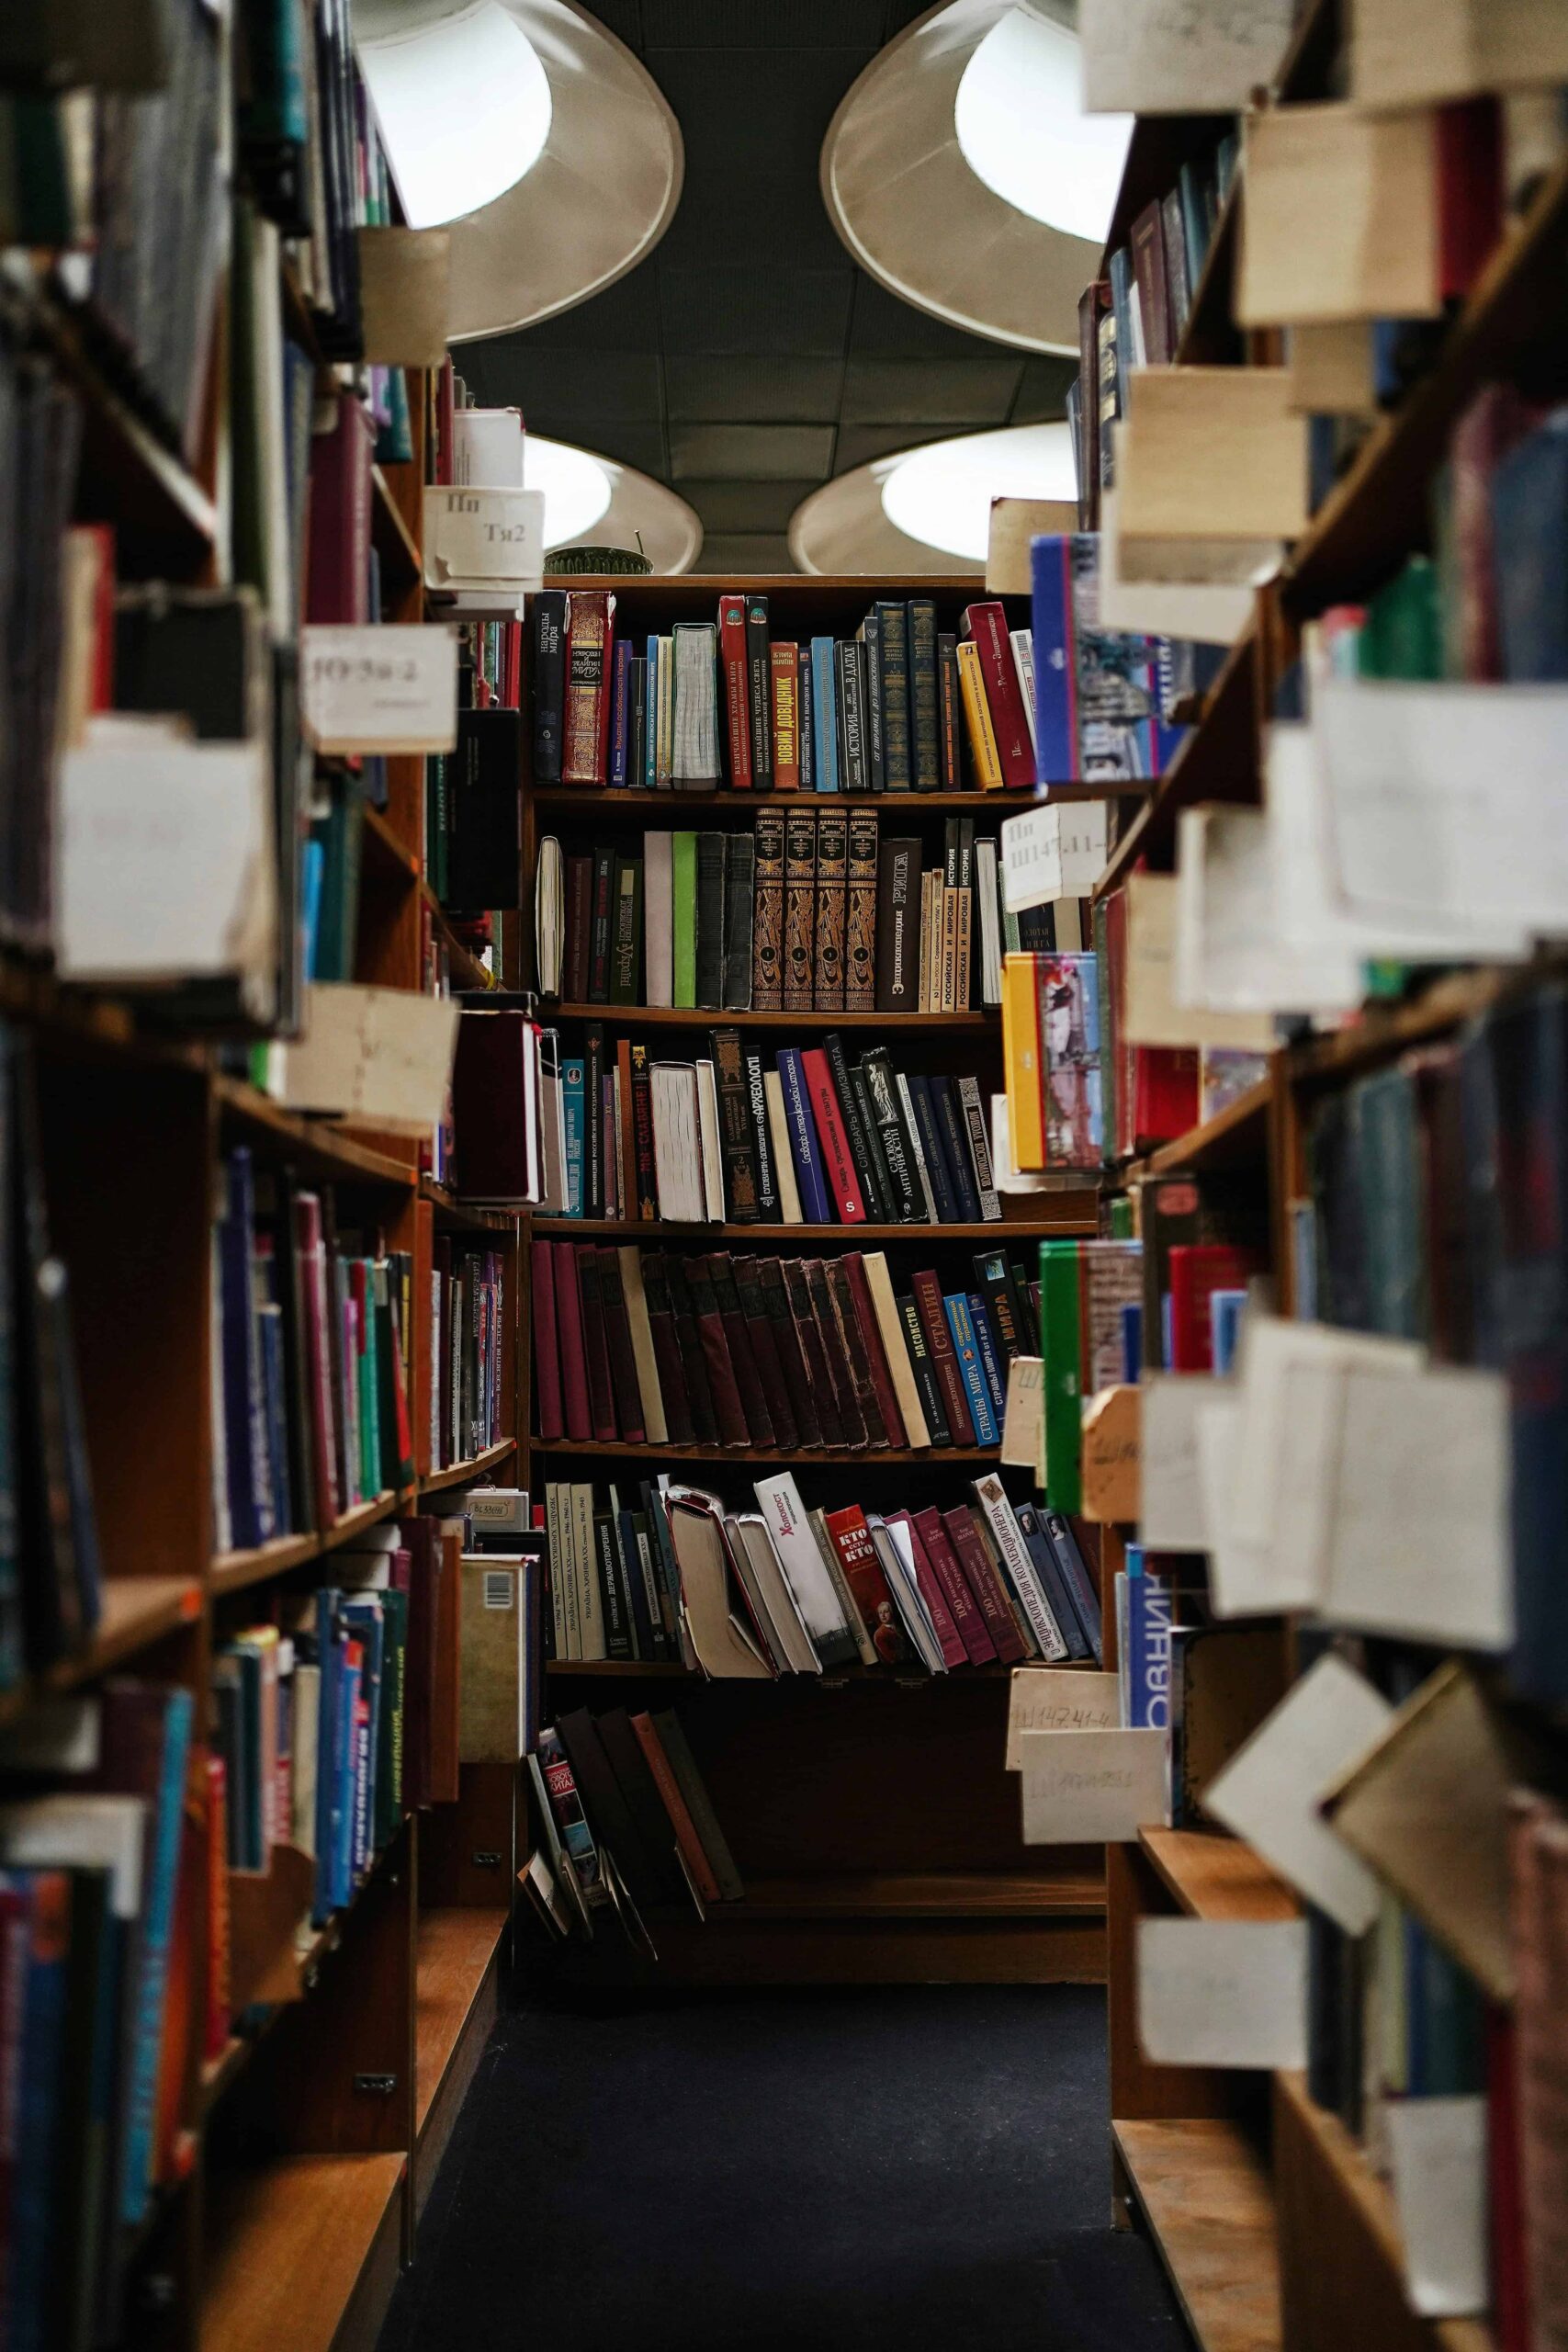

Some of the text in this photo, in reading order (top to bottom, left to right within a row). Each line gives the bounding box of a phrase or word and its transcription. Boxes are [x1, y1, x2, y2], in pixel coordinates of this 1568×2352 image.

[539, 612, 550, 653] народы
[548, 626, 558, 654] мира
[844, 647, 857, 676] ДАТАХ
[730, 686, 739, 715] ХРАМЫ
[737, 661, 748, 775] ЭНЦИКЛОПЕДИЧЕСКИЙ СПРАВОЧНИК
[753, 684, 762, 715] ЧУДЕСА
[871, 697, 880, 710] ДО
[761, 701, 771, 774] ЭНЦИКЛОПЕДИЧЕСКИЙ
[773, 677, 795, 765] НОВИЙ ДОВІДНИК
[847, 714, 860, 757] ИСТОРИЯ
[871, 713, 881, 750] ПИРАМИД
[730, 717, 741, 775] ВЕЛИЧАЙШИЕ
[754, 717, 763, 773] ВЕЛИЧАЙШИЕ
[873, 752, 881, 762] ОТ
[961, 849, 970, 886] ИСТОРИЯ
[891, 852, 908, 995] Энциклопедия РИГА
[946, 895, 954, 934] МИРОВАЯ
[960, 895, 968, 934] МИРОВАЯ
[615, 945, 634, 987] Україні
[943, 951, 953, 1005] РОССИЙСКАЯ
[957, 952, 967, 1005] РОССИЙСКАЯ
[785, 1057, 811, 1164] Словарь американской истории
[820, 1088, 834, 1117] культуры
[831, 1046, 869, 1168] СЛОВАРЬ НУМИЗМАТА
[860, 1098, 874, 1130] НАЗВАНИЙ
[917, 1092, 933, 1139] ИСТОРИЧЕСКИЙ
[590, 1119, 598, 1158] РОССИЙСКОЙ
[942, 1092, 963, 1166] СЛОВАРЬ ИСТОРИЧЕСКИЙ
[969, 1111, 992, 1187] МИКОЛА КОСТОМАРОВ
[882, 1129, 897, 1173] СЛОВАРЬ
[891, 1128, 913, 1197] АНТИЧНОСТИ
[930, 1140, 940, 1167] СЛОВАРЬ
[905, 1306, 927, 1358] МАСОНСТВО
[919, 1282, 948, 1350] СТАЛИН
[949, 1300, 965, 1347] современный
[958, 1302, 972, 1341] справочник
[979, 1325, 987, 1334] до
[994, 1293, 1017, 1340] МИРА
[981, 1350, 997, 1373] МИРА
[982, 1340, 991, 1350] от
[943, 1363, 965, 1429] ЭНЦИКЛОПЕДИЯ
[967, 1363, 993, 1441] СТРАНЫ МИРА
[989, 1373, 1004, 1406] СТРАНЫ
[772, 1493, 795, 1537] Холокост
[812, 1519, 829, 1545] истории
[839, 1528, 867, 1546] КТО
[844, 1544, 874, 1563] КТО
[991, 1505, 1029, 1580] КОЛЛЕКЦИОНЕРА
[601, 1524, 616, 1595] ДЕРЖАВОТВОРЕННЯ
[947, 1555, 964, 1588] України
[974, 1548, 989, 1575] Україну
[938, 1558, 968, 1619] 100 визначних
[984, 1598, 998, 1618] 100
[1017, 1580, 1055, 1650] ЭНЦИКЛОПЕДИЯ
